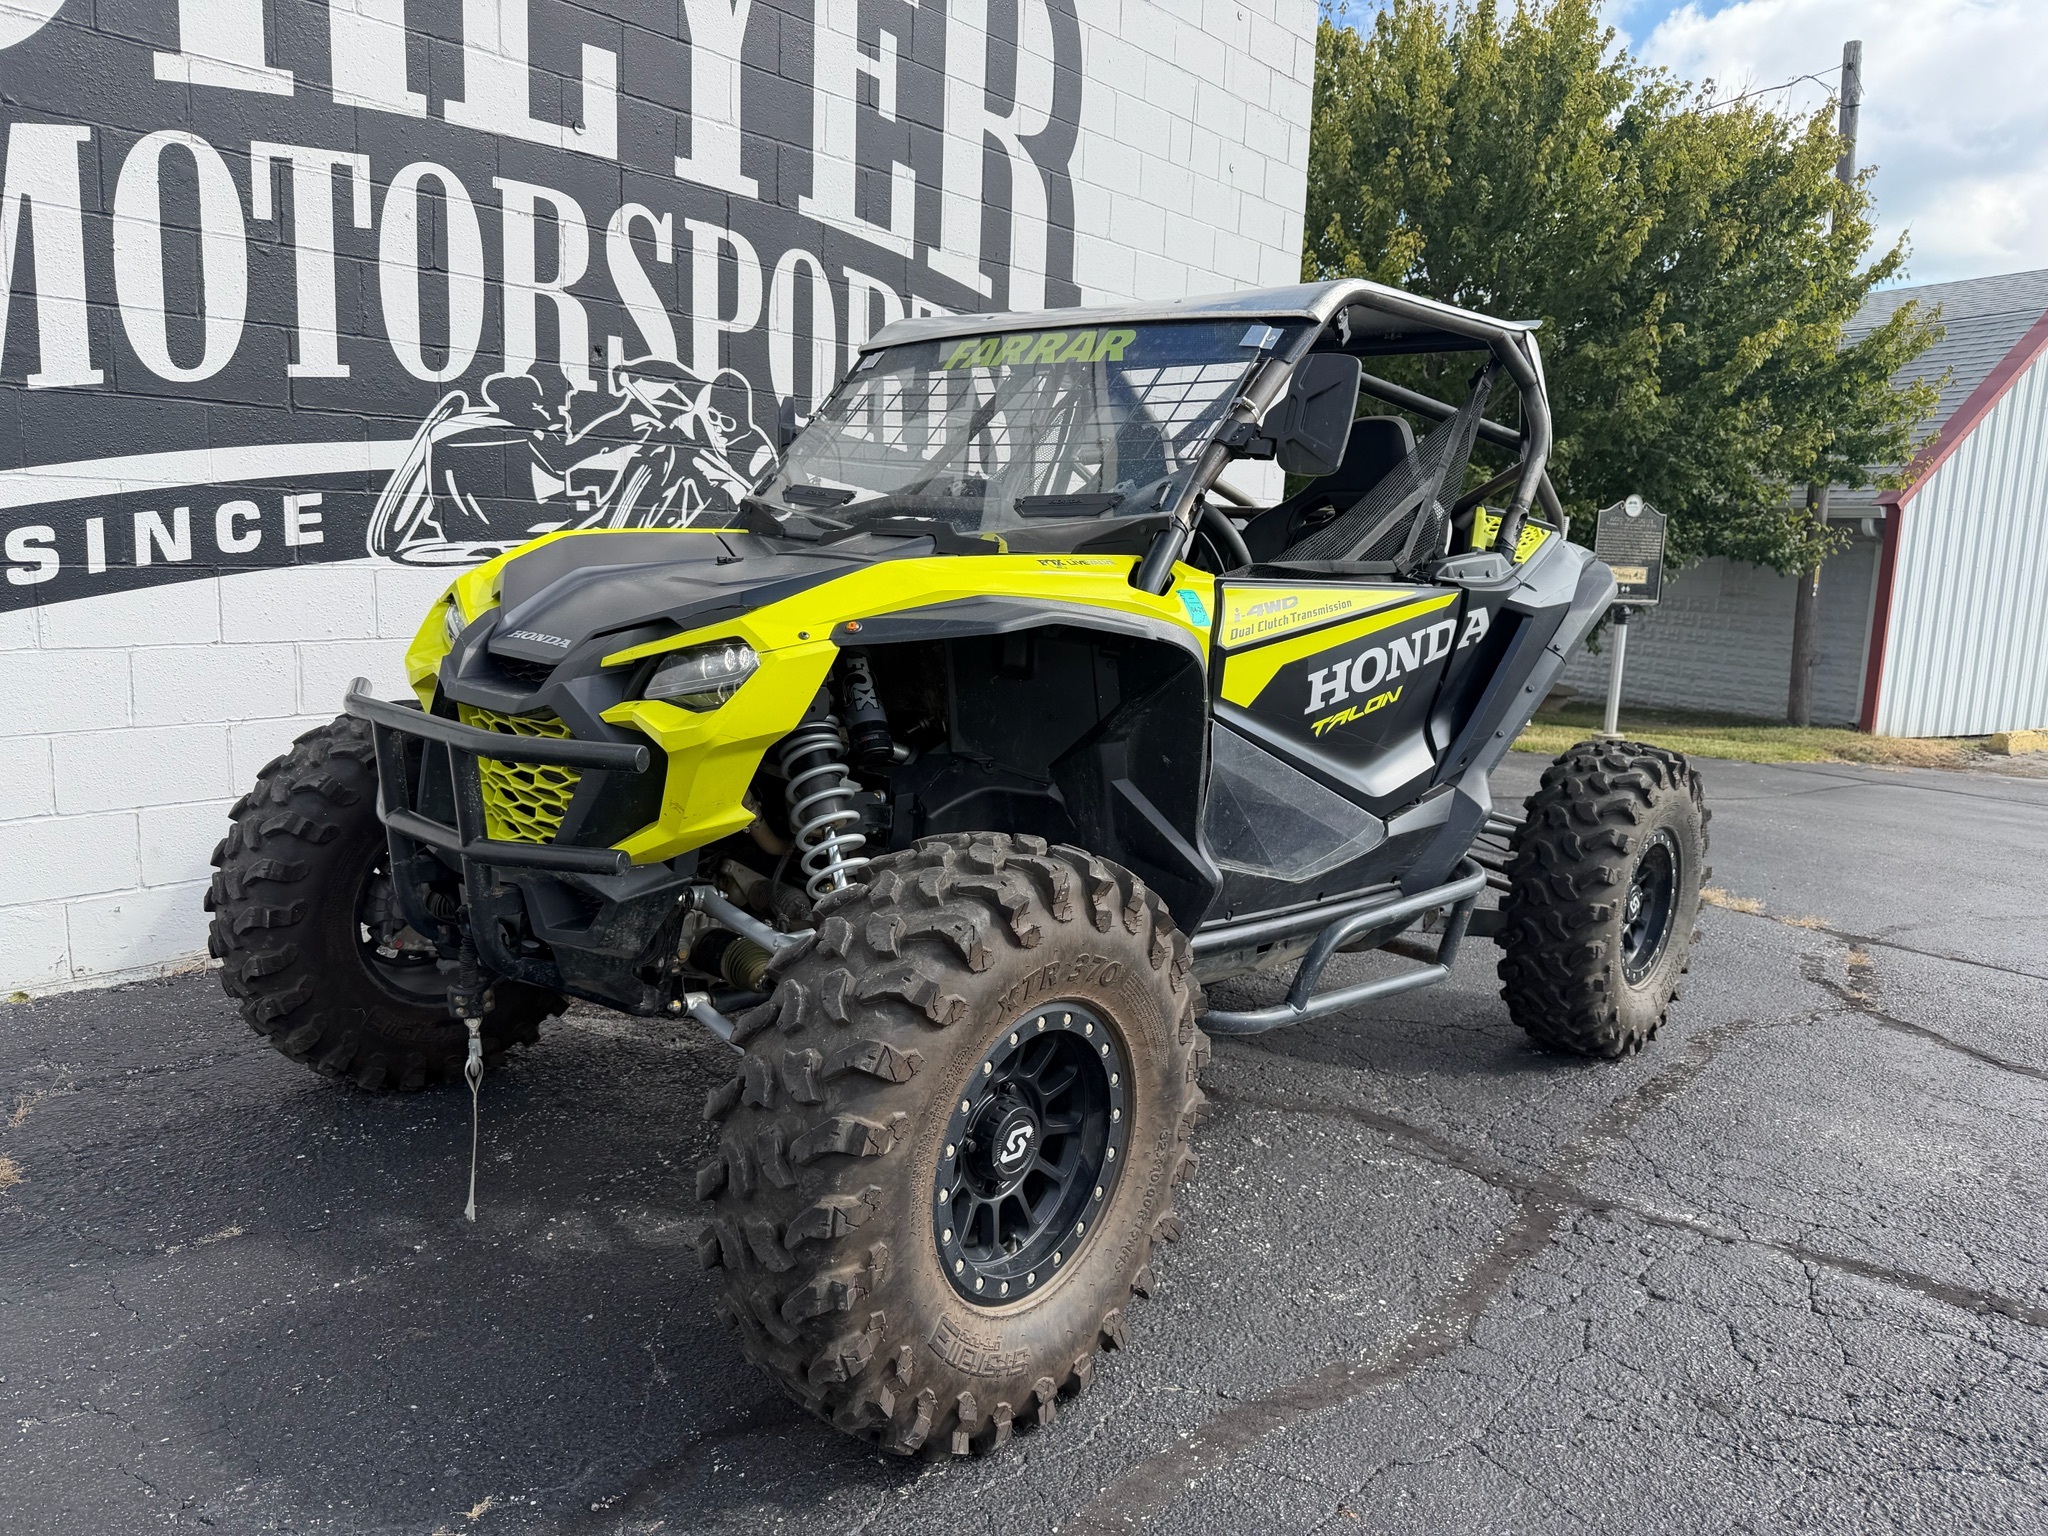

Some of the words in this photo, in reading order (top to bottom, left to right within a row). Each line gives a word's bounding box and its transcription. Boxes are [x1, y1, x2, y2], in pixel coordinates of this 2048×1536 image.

[942, 329, 1137, 370] FARRAR
[5, 492, 325, 586] SINCE
[507, 629, 571, 649] HONDA
[1230, 621, 1255, 641] Dual
[1257, 616, 1290, 634] Clutch
[1290, 599, 1353, 624] Transmission
[843, 656, 879, 712] FOX
[1304, 606, 1491, 716] HONDA
[1310, 685, 1404, 738] TALON
[995, 960, 1061, 1026] XTR
[1066, 952, 1123, 988] 370
